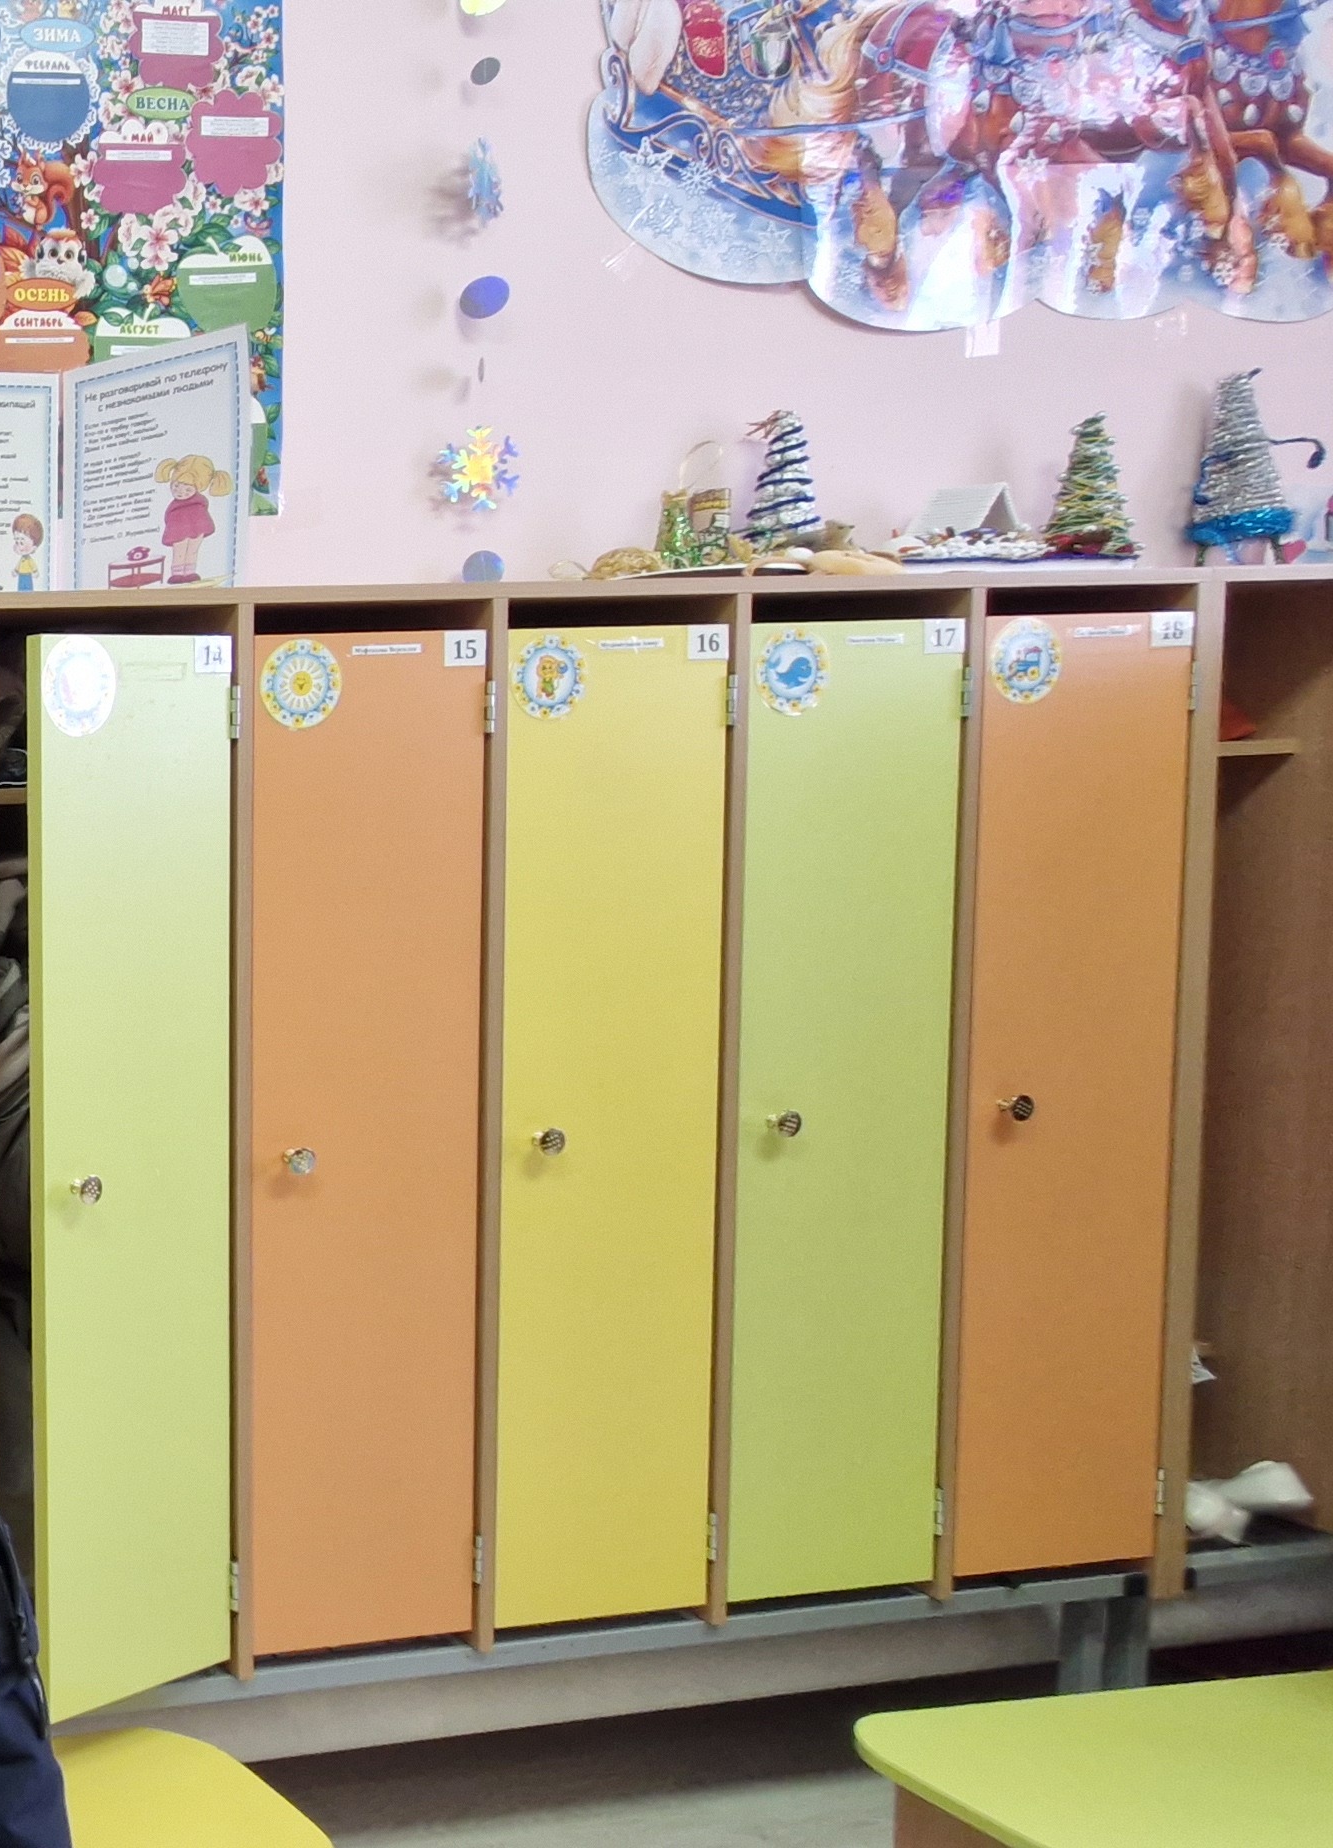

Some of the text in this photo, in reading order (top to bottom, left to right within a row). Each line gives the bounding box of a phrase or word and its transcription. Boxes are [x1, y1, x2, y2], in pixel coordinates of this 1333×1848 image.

[33, 28, 81, 43] ЗИМА
[135, 97, 191, 111] ВЕСНА
[131, 132, 154, 143] МАЙ
[229, 252, 263, 263] ИЮНЬ
[13, 287, 70, 303] ОСЕНЬ
[14, 318, 63, 327] СЕНТЯБРЬ
[119, 324, 159, 334] АВГУСТ
[84, 362, 229, 403] Не разговаривай по телефону
[105, 387, 170, 410] незнакомыми
[172, 378, 214, 395] людьми
[0, 399, 36, 409] кипящей
[697, 632, 721, 653] 16
[933, 628, 957, 647] 17
[453, 639, 477, 660] 15
